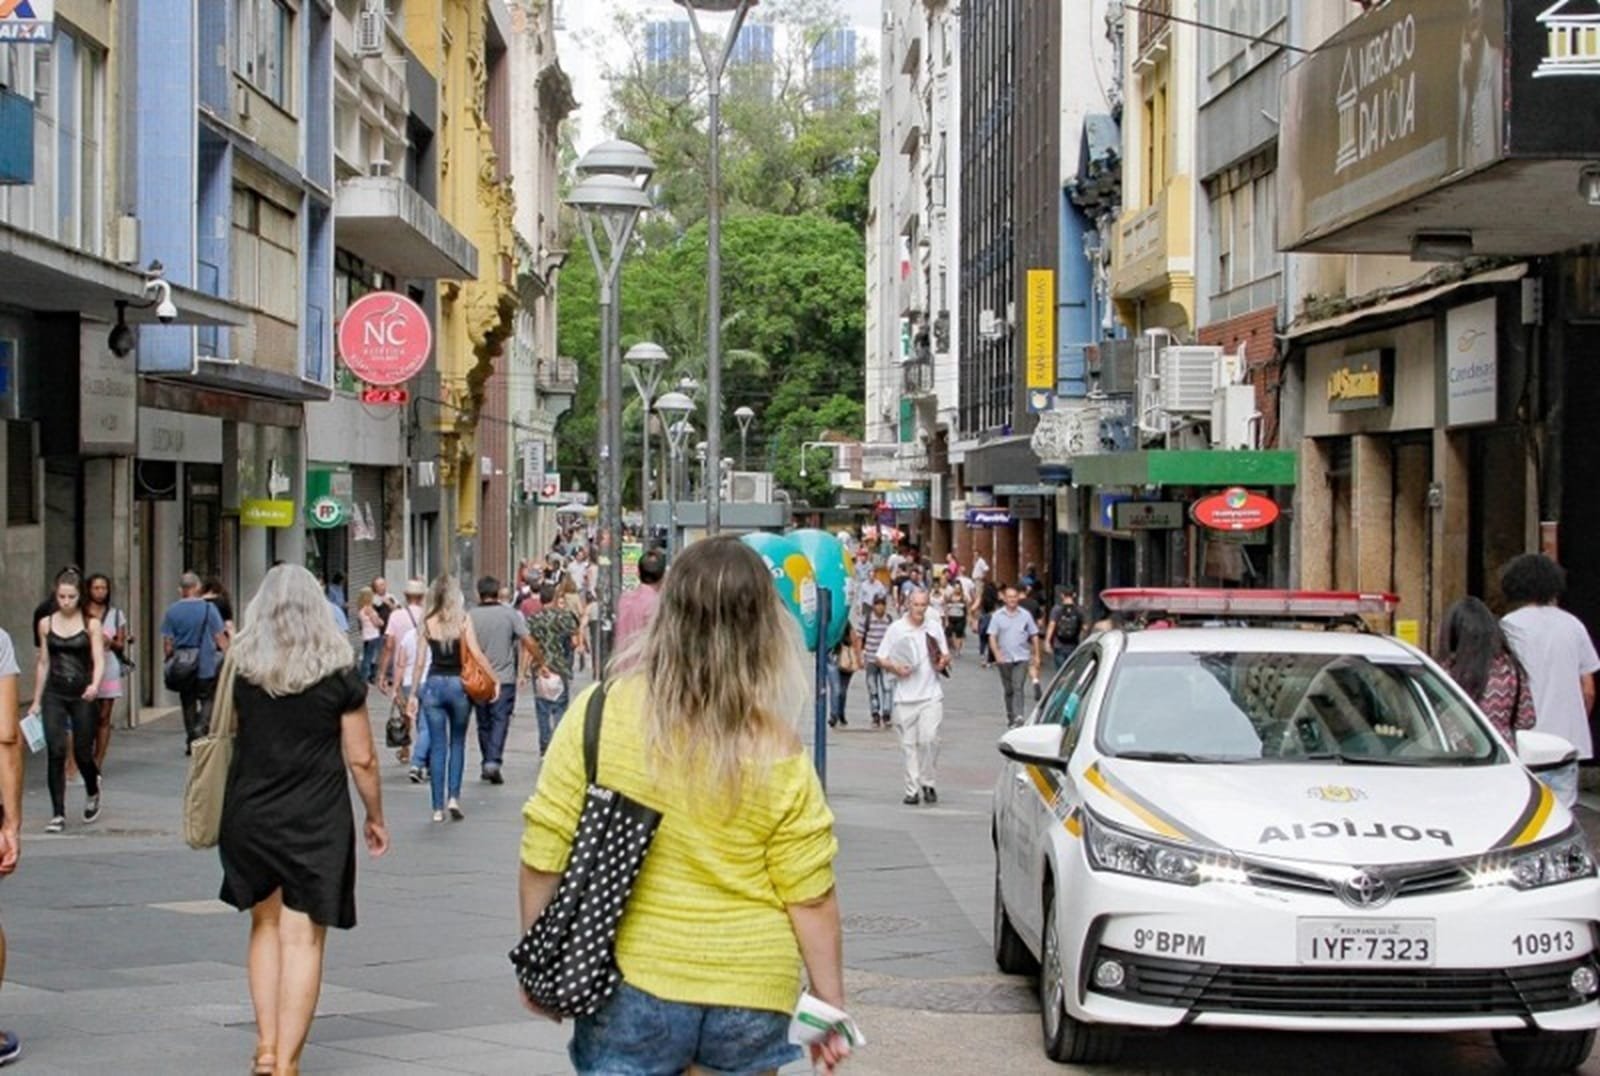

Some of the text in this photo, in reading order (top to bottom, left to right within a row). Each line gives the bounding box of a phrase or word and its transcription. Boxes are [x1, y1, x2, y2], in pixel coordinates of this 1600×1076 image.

[0, 23, 47, 40] AIXA
[1359, 13, 1415, 91] MERCADO
[1359, 93, 1379, 160] DA
[363, 318, 407, 346] NC
[1512, 930, 1575, 956] 10913
